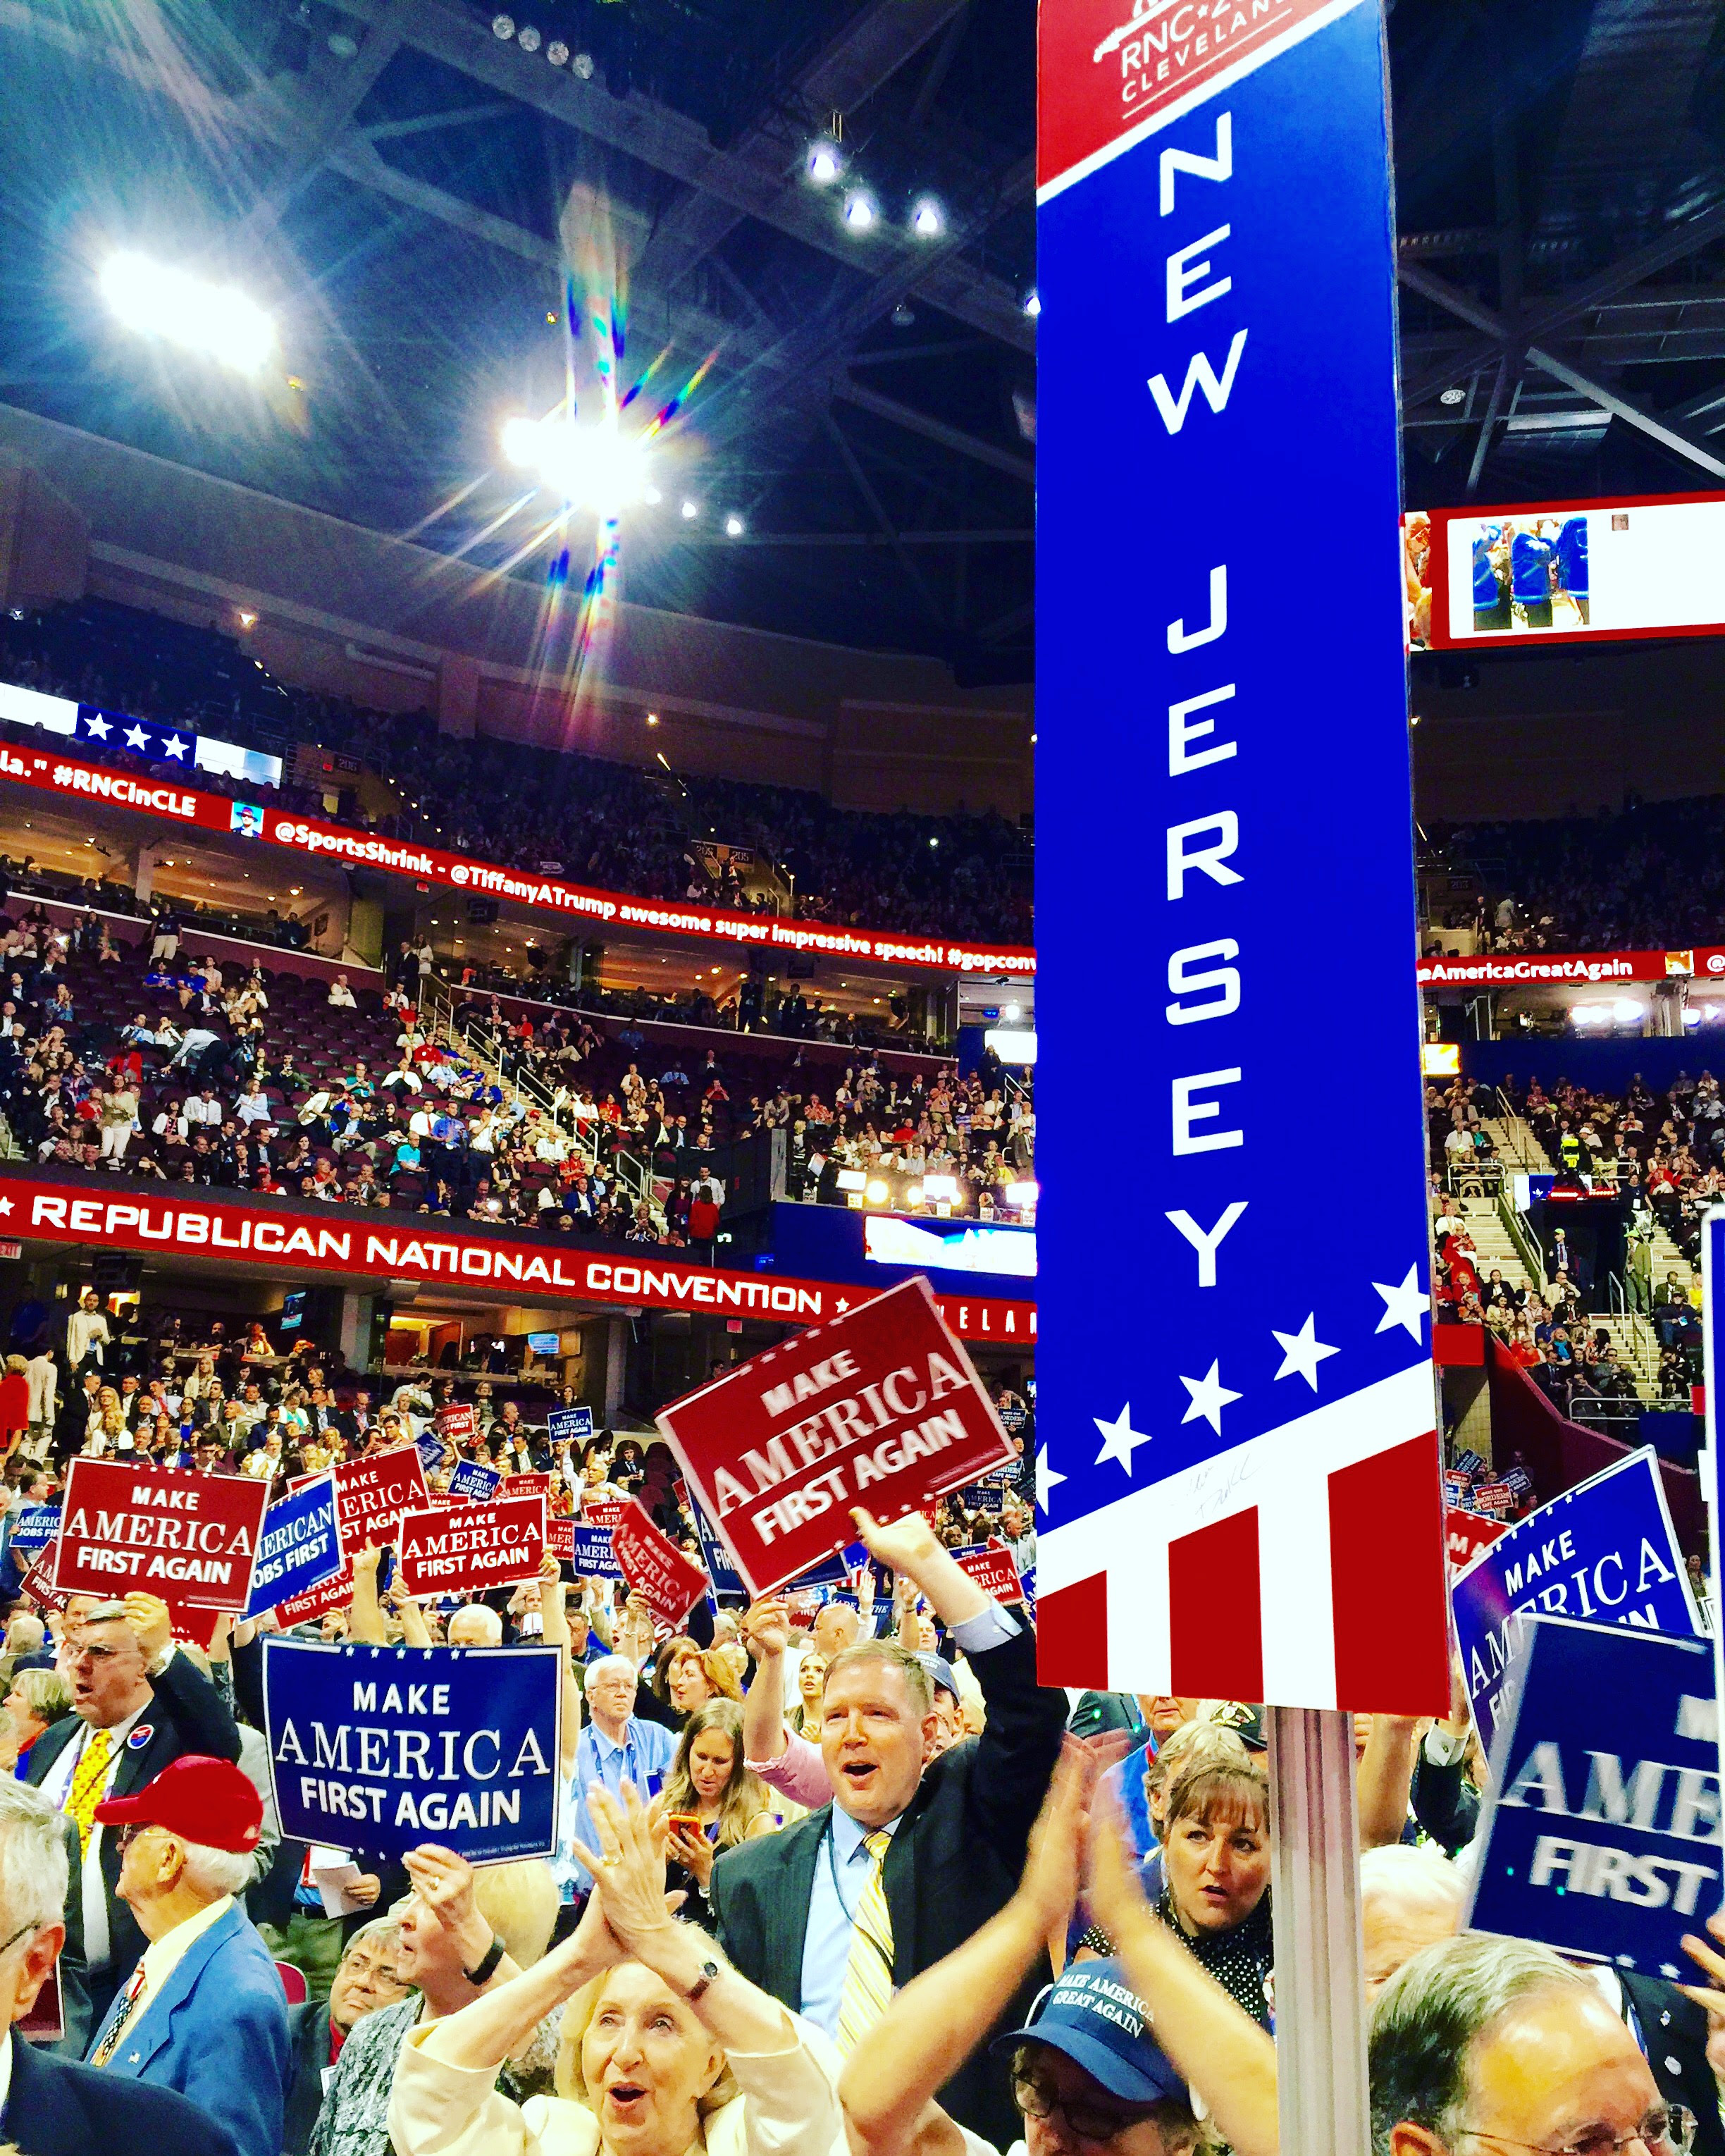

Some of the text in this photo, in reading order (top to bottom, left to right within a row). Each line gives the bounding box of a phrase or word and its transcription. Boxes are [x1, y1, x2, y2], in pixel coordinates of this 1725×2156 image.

[1122, 0, 1282, 102] CLEVELAN
[1148, 111, 1247, 434] NEW
[52, 765, 197, 818] #RNCinCLE
[275, 823, 433, 875] @SportsShrink
[450, 865, 616, 919] @TiffanyATrump
[619, 905, 711, 932] awesome
[715, 919, 769, 941] super
[772, 924, 871, 955] impressive
[874, 942, 943, 963] speech!
[1165, 564, 1249, 1287] JERSEY
[1417, 959, 1633, 981] eAmericaGreatAgain
[32, 1195, 822, 1315] REPUBLICAN NATIONAL CONVENTION
[760, 1348, 862, 1418] MAKE
[550, 1417, 591, 1431] AMERICA
[554, 1428, 569, 1436] FIRST
[712, 1352, 972, 1520] AMERICA
[336, 1470, 379, 1493] MAKE
[454, 1473, 495, 1493] AMERICA
[455, 1482, 490, 1499] FIRST AGAIN
[473, 1469, 488, 1480] MAKE
[506, 1485, 550, 1496] AMERICA
[751, 1408, 970, 1546] FIRST AGAIN
[132, 1485, 200, 1511] MAKE
[18, 1528, 42, 1536] JOBS
[63, 1507, 253, 1557] AMERICA
[449, 1513, 497, 1529] MAKE
[285, 1532, 328, 1572] FIRST
[402, 1522, 542, 1560] AMERICA
[77, 1546, 233, 1585] FIRST AGAIN
[416, 1546, 529, 1579] FIRST AGAIN
[579, 1558, 598, 1570] FIRST
[967, 1561, 991, 1574] MAKE
[1504, 1529, 1576, 1598] MAKE
[284, 1595, 317, 1616] FIRST
[635, 1576, 676, 1612] AGAIN
[353, 1681, 450, 1715] MAKE
[275, 1717, 551, 1781] AMERICA
[299, 1776, 521, 1831] FIRST AGAIN
[1529, 1835, 1719, 1916] FIRST
[1052, 1990, 1144, 2038] GREAT AGAIN
[1056, 1974, 1154, 2023] MAKE AMERICA
